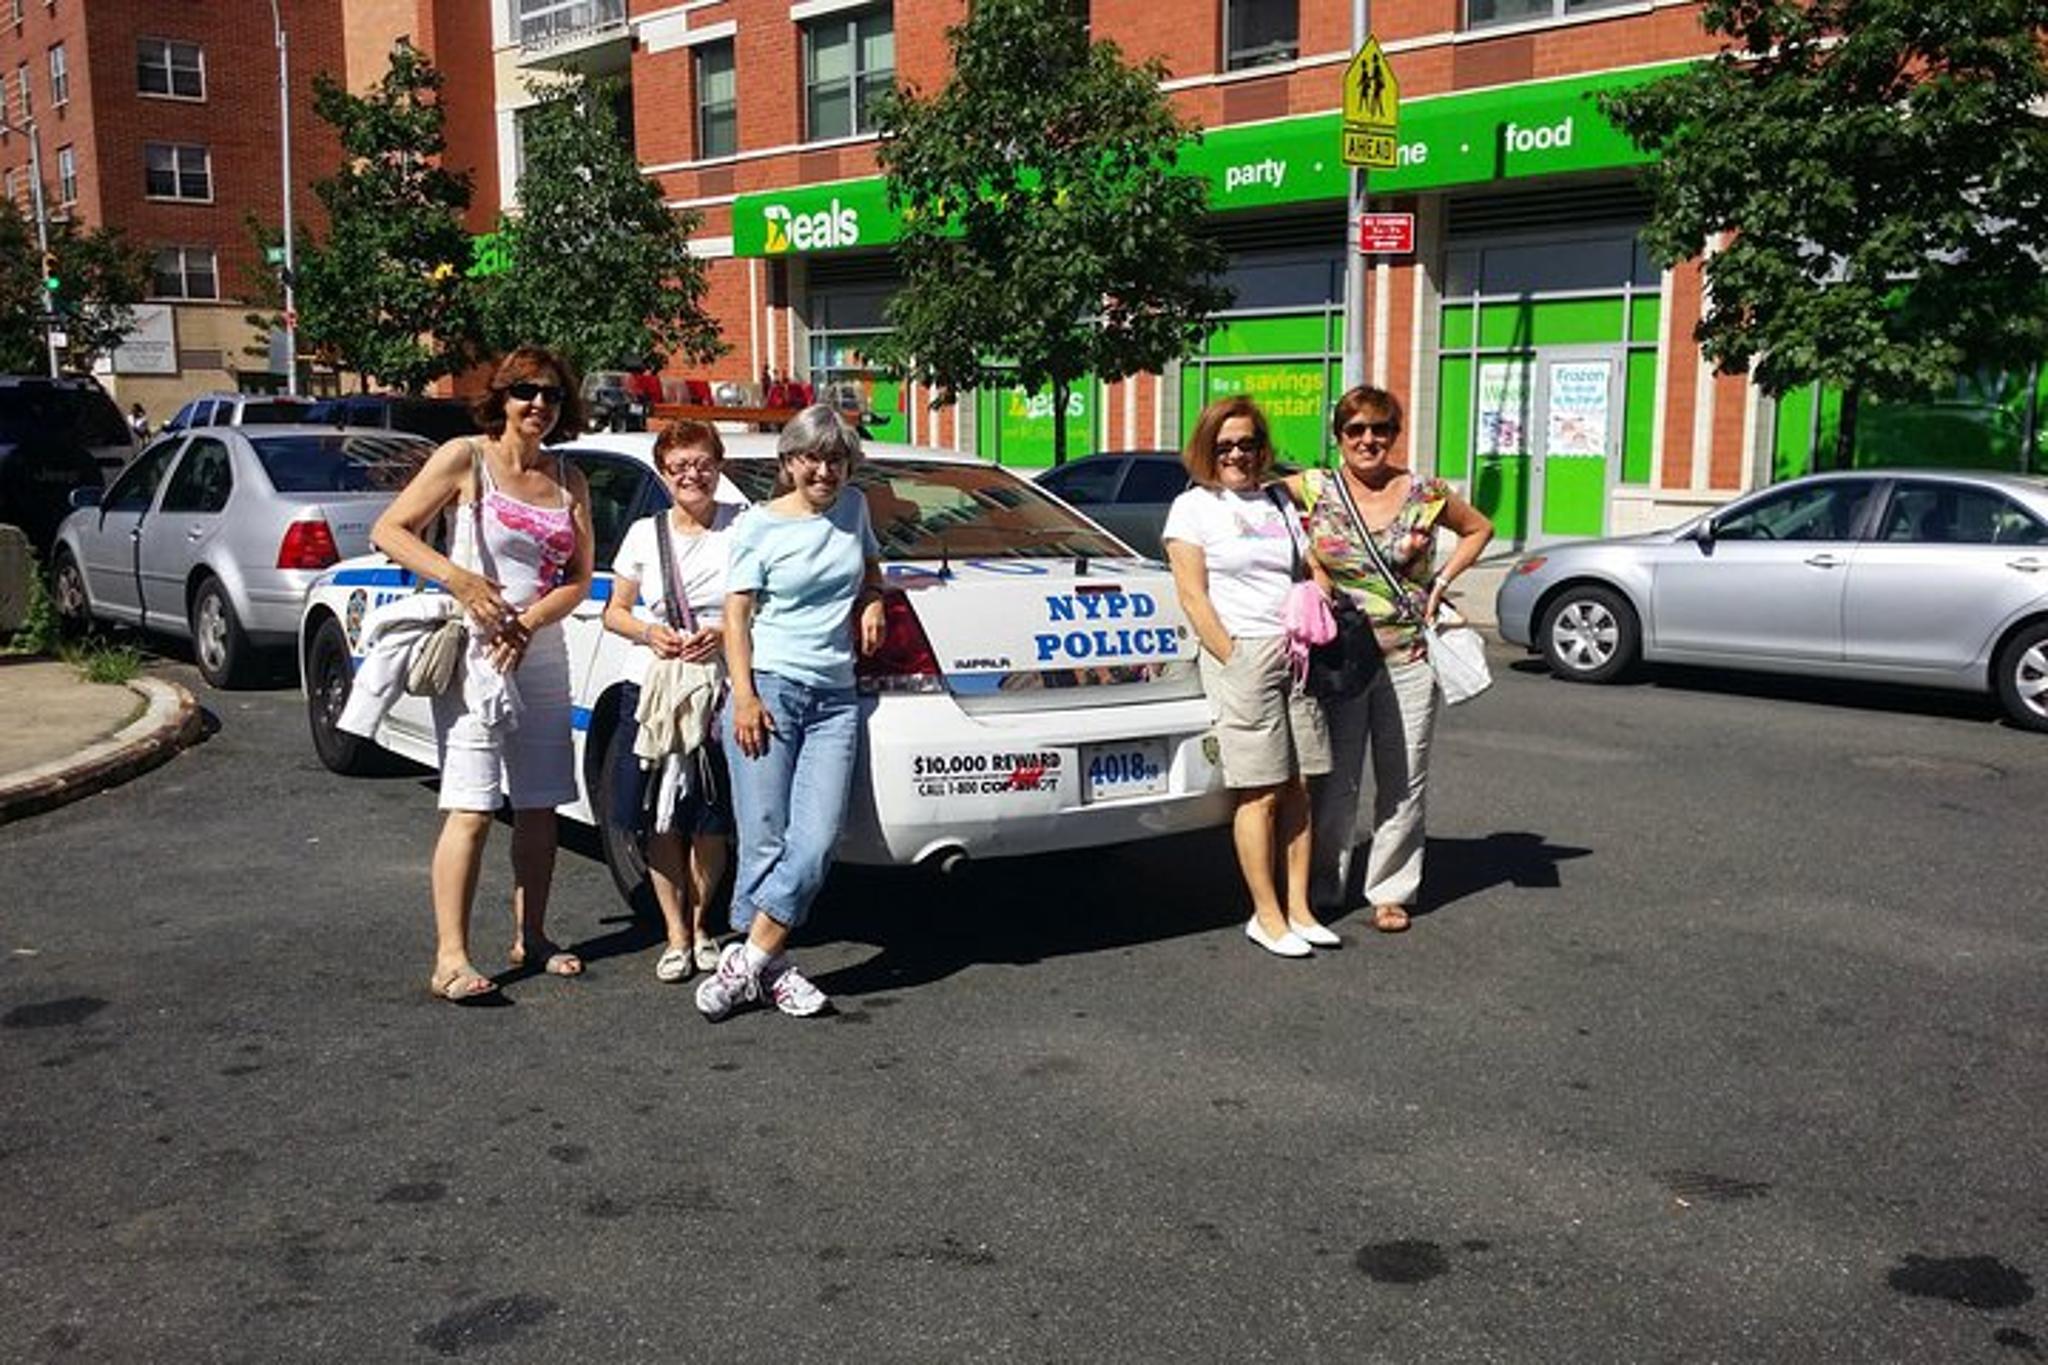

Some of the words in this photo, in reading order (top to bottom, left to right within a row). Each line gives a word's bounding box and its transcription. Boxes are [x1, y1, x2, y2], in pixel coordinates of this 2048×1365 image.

[1347, 137, 1391, 160] AHEAD
[1505, 116, 1573, 152] food
[1225, 158, 1286, 191] party
[764, 198, 859, 254] Deals
[1245, 373, 1323, 396] savings
[1046, 593, 1155, 621] NYPD
[1034, 628, 1178, 661] POLICE
[992, 753, 1061, 771] REWARD
[1088, 752, 1144, 785] 4018
